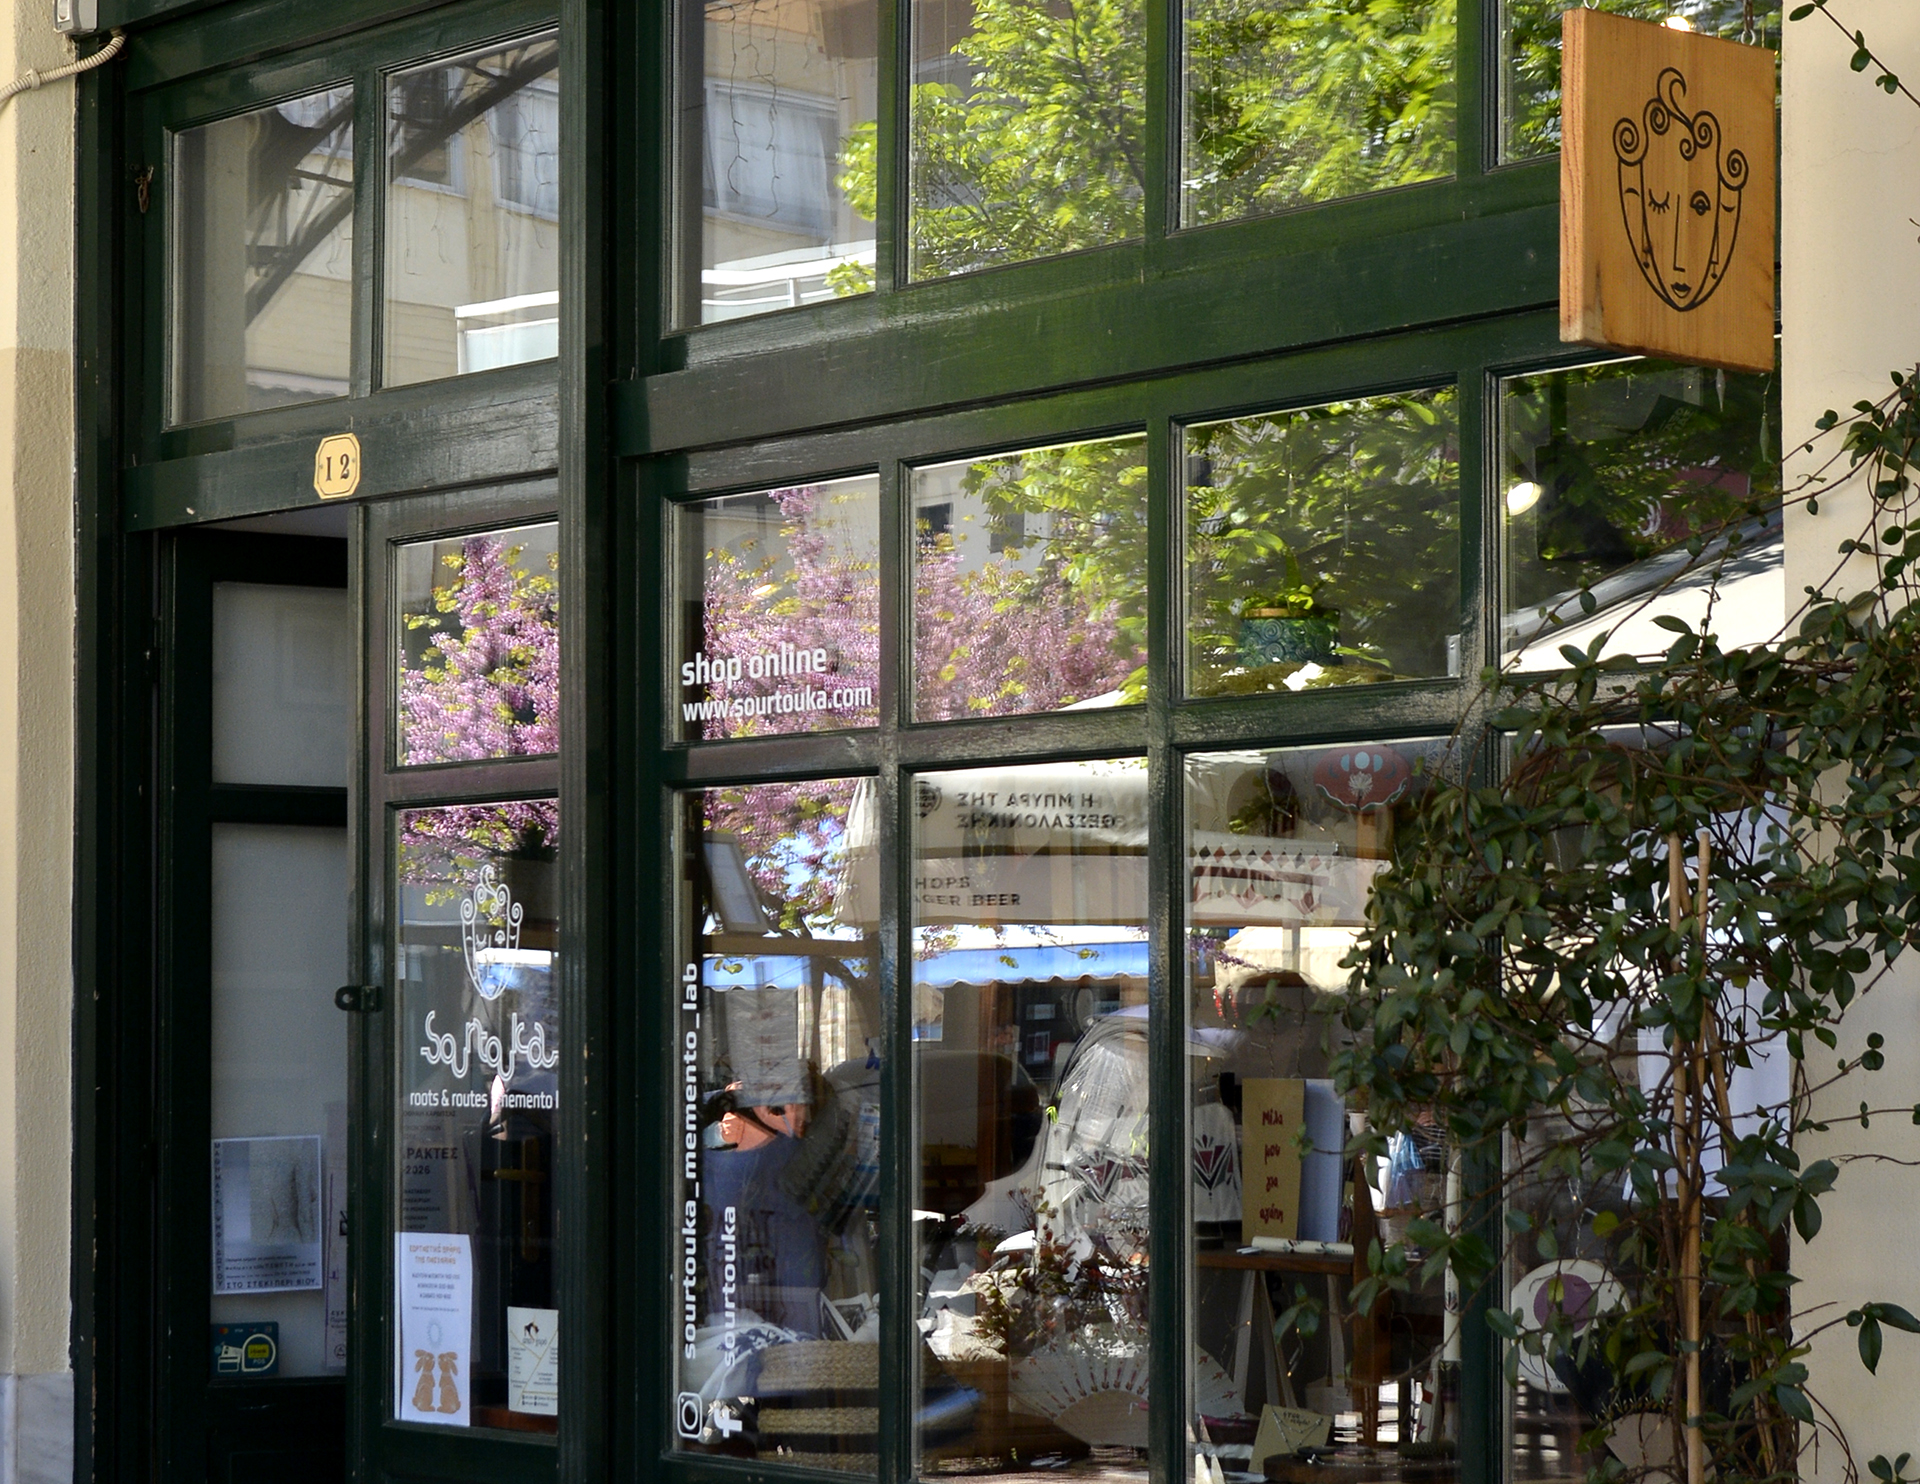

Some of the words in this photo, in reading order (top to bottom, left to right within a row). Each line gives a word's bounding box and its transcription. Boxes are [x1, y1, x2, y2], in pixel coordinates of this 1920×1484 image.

[326, 453, 350, 481] 12
[681, 651, 742, 690] shop
[749, 641, 827, 679] online
[682, 684, 872, 722] www.sourtouka.com
[915, 876, 970, 889] HOPS
[972, 893, 1021, 906] BEER
[410, 1089, 439, 1107] roots
[441, 1089, 450, 1107] &
[452, 1089, 488, 1108] routes
[682, 962, 700, 1360] sourtouka_memento_lab
[720, 1206, 736, 1368] sourtouka
